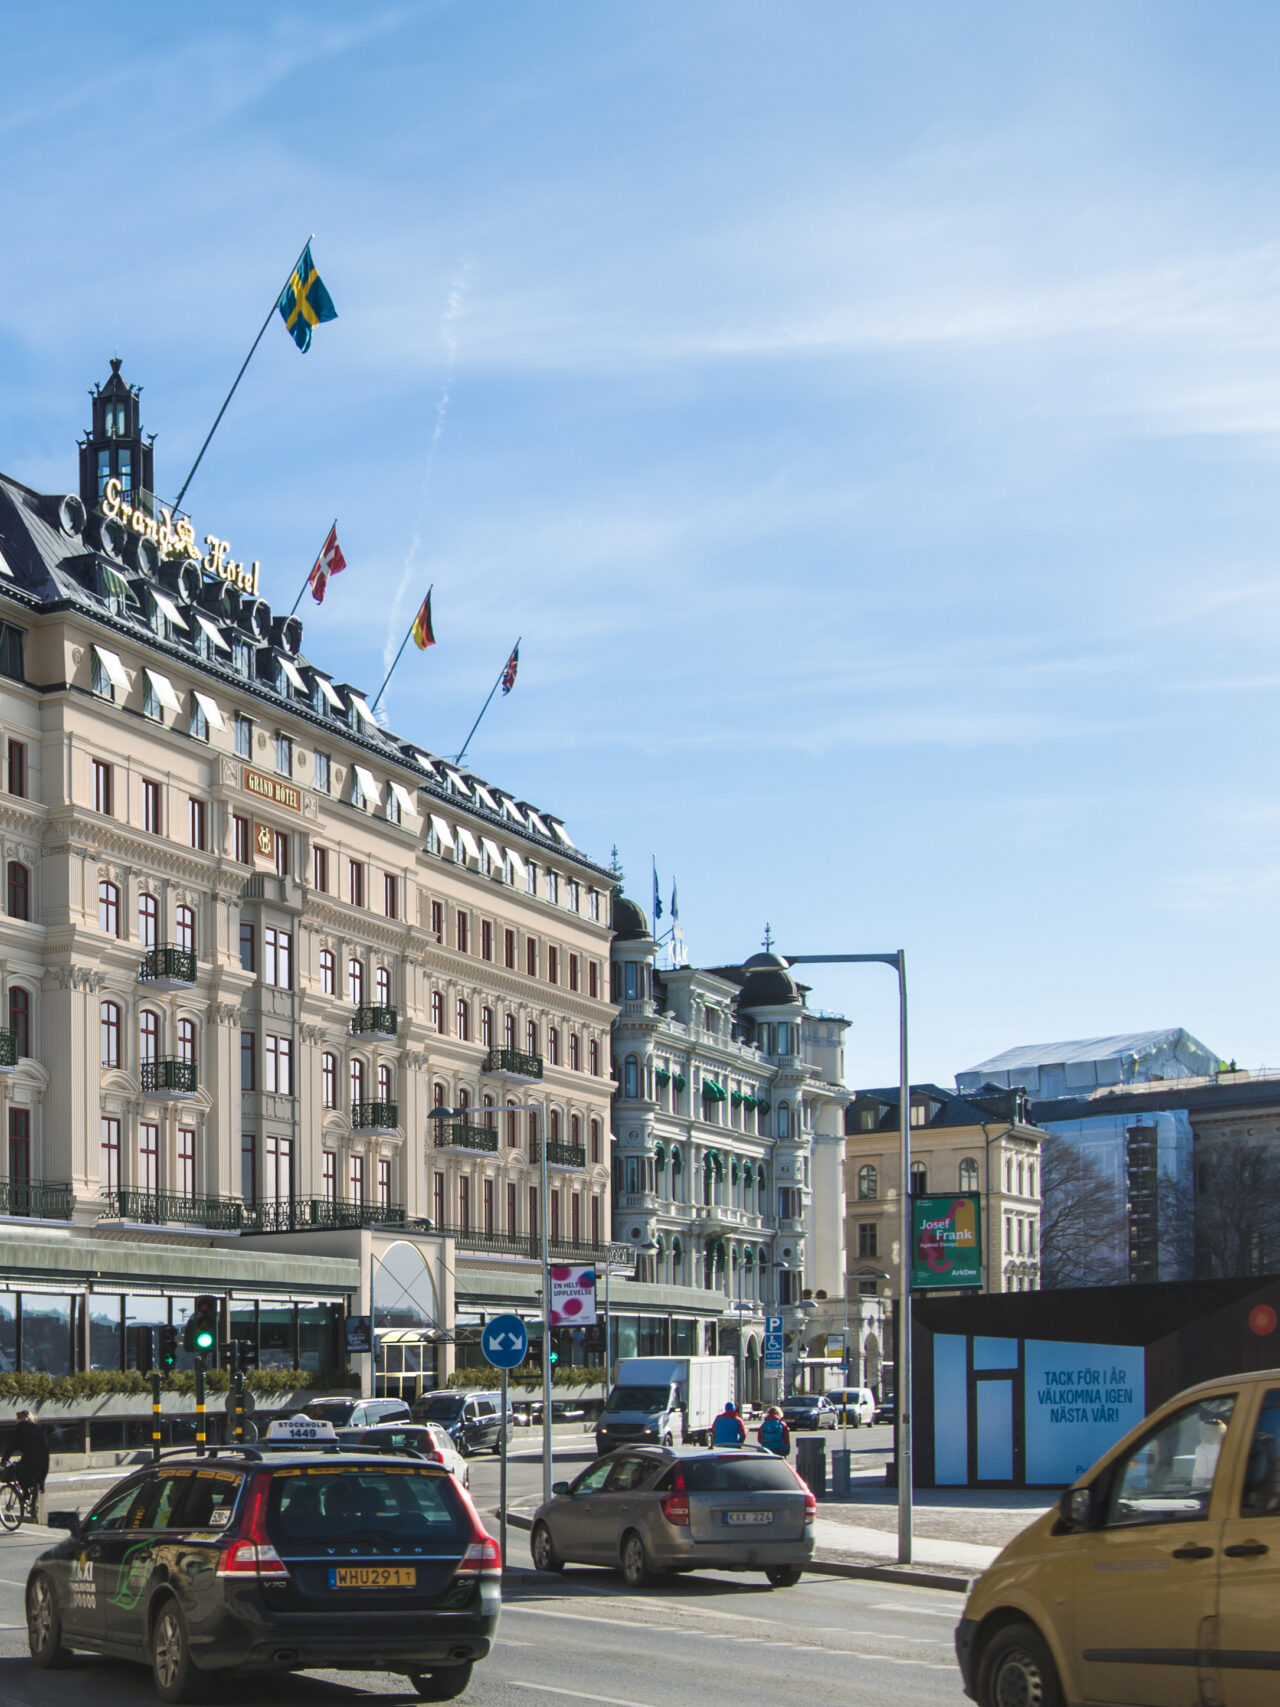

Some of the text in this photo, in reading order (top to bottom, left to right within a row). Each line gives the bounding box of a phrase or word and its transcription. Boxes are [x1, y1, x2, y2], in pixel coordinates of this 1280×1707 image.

[101, 478, 172, 552] Grand
[248, 773, 273, 797] GRAND
[920, 1218, 951, 1230] Josef
[936, 1229, 972, 1240] Frank
[553, 1289, 593, 1297] UPPLEVELSE
[769, 1317, 781, 1333] P
[1044, 1365, 1127, 1387] TACK FÖR I ÅR
[1037, 1387, 1134, 1405] VÄLKOMNA IGEN
[1050, 1403, 1120, 1423] NÄSTA VÅR!
[289, 1429, 317, 1438] 1449
[338, 1569, 402, 1586] WHU291
